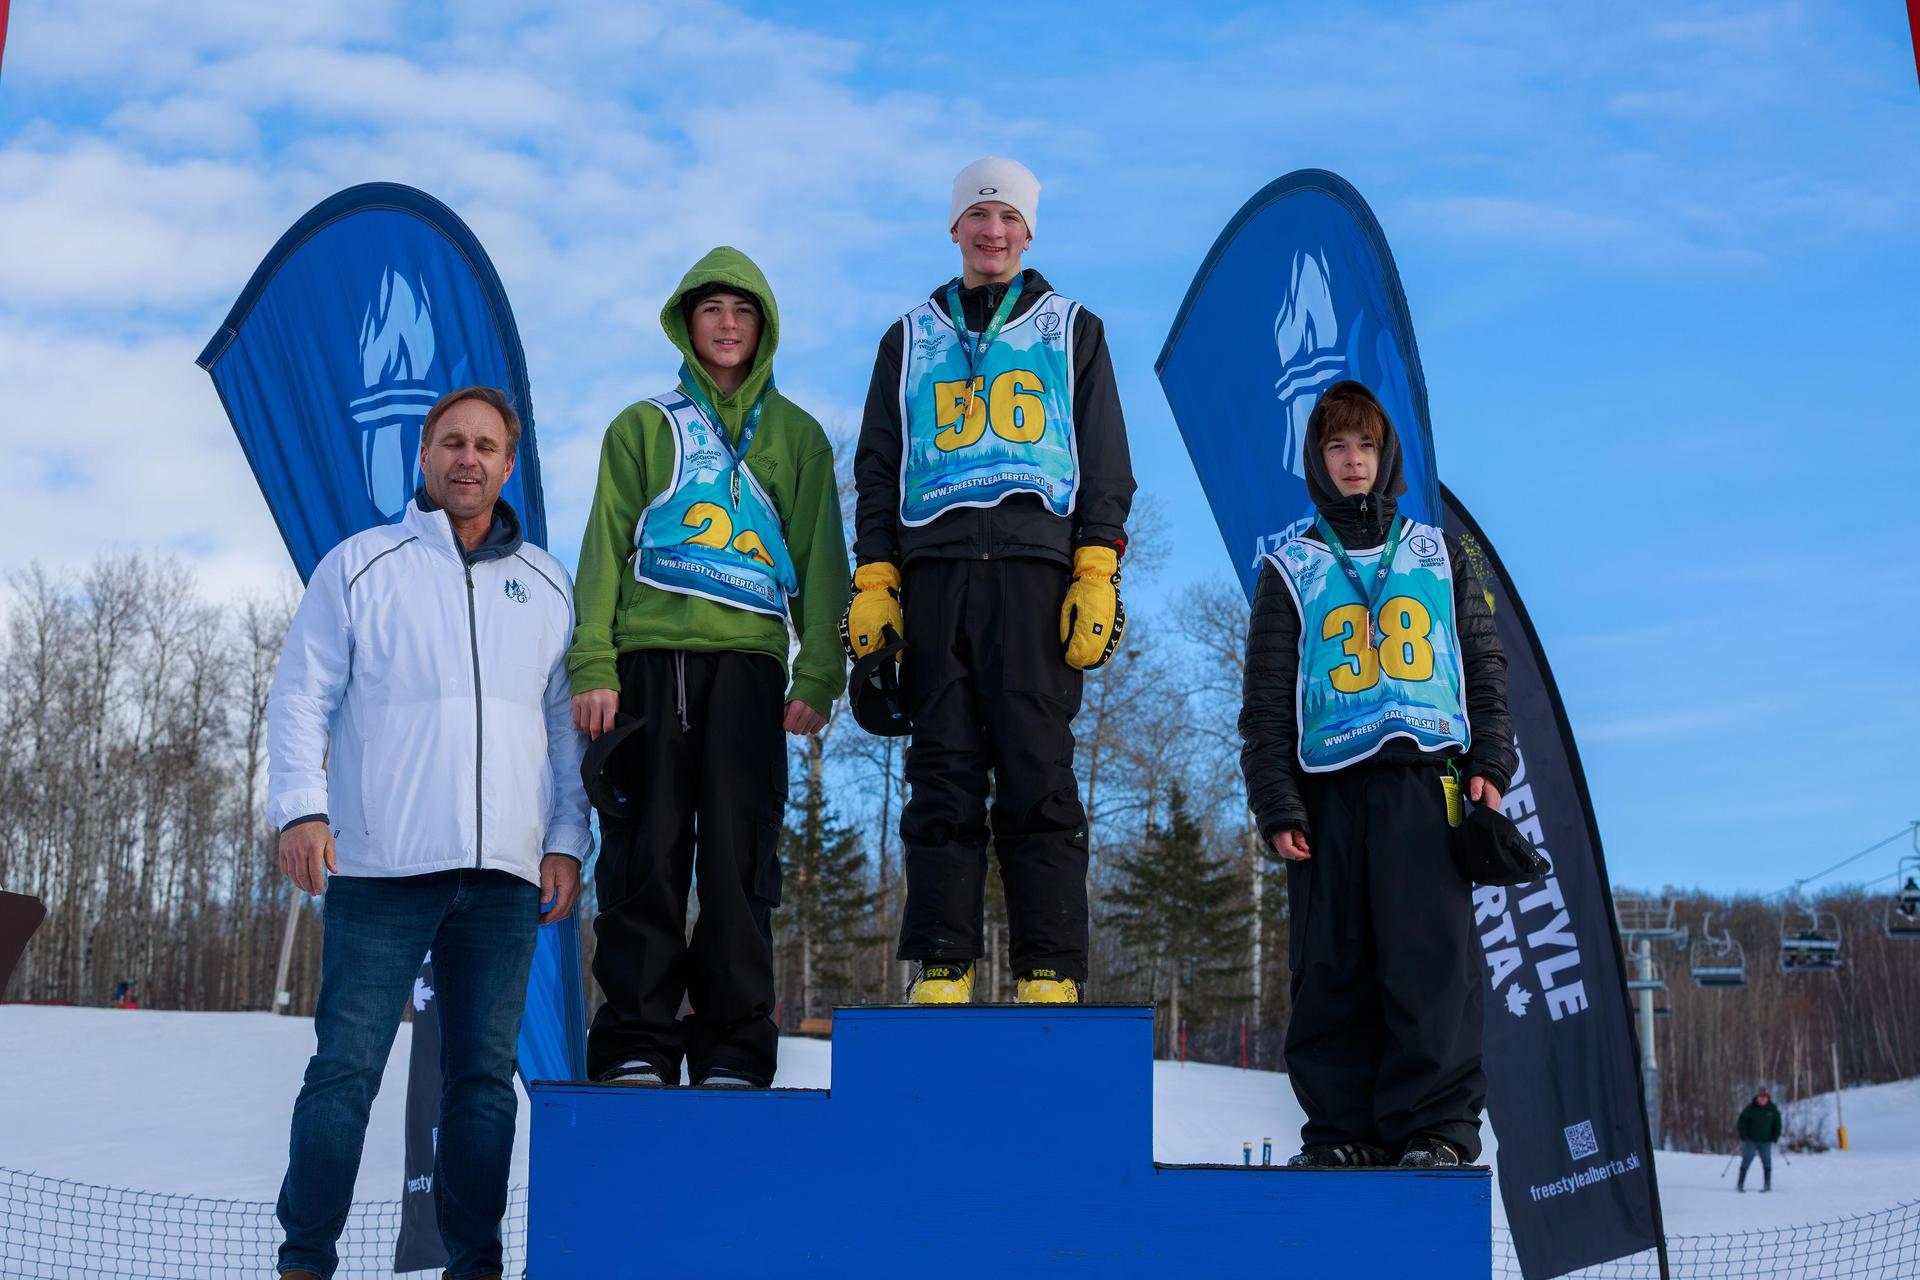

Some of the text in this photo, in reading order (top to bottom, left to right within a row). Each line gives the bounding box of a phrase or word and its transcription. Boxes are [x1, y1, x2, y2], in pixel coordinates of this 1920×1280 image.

[934, 370, 1046, 452] 56
[656, 557, 766, 595] WWW.FREESTYLEALBERTA.SKI
[1323, 596, 1434, 694] 38
[1530, 1152, 1641, 1202] freestylealberta.ski
